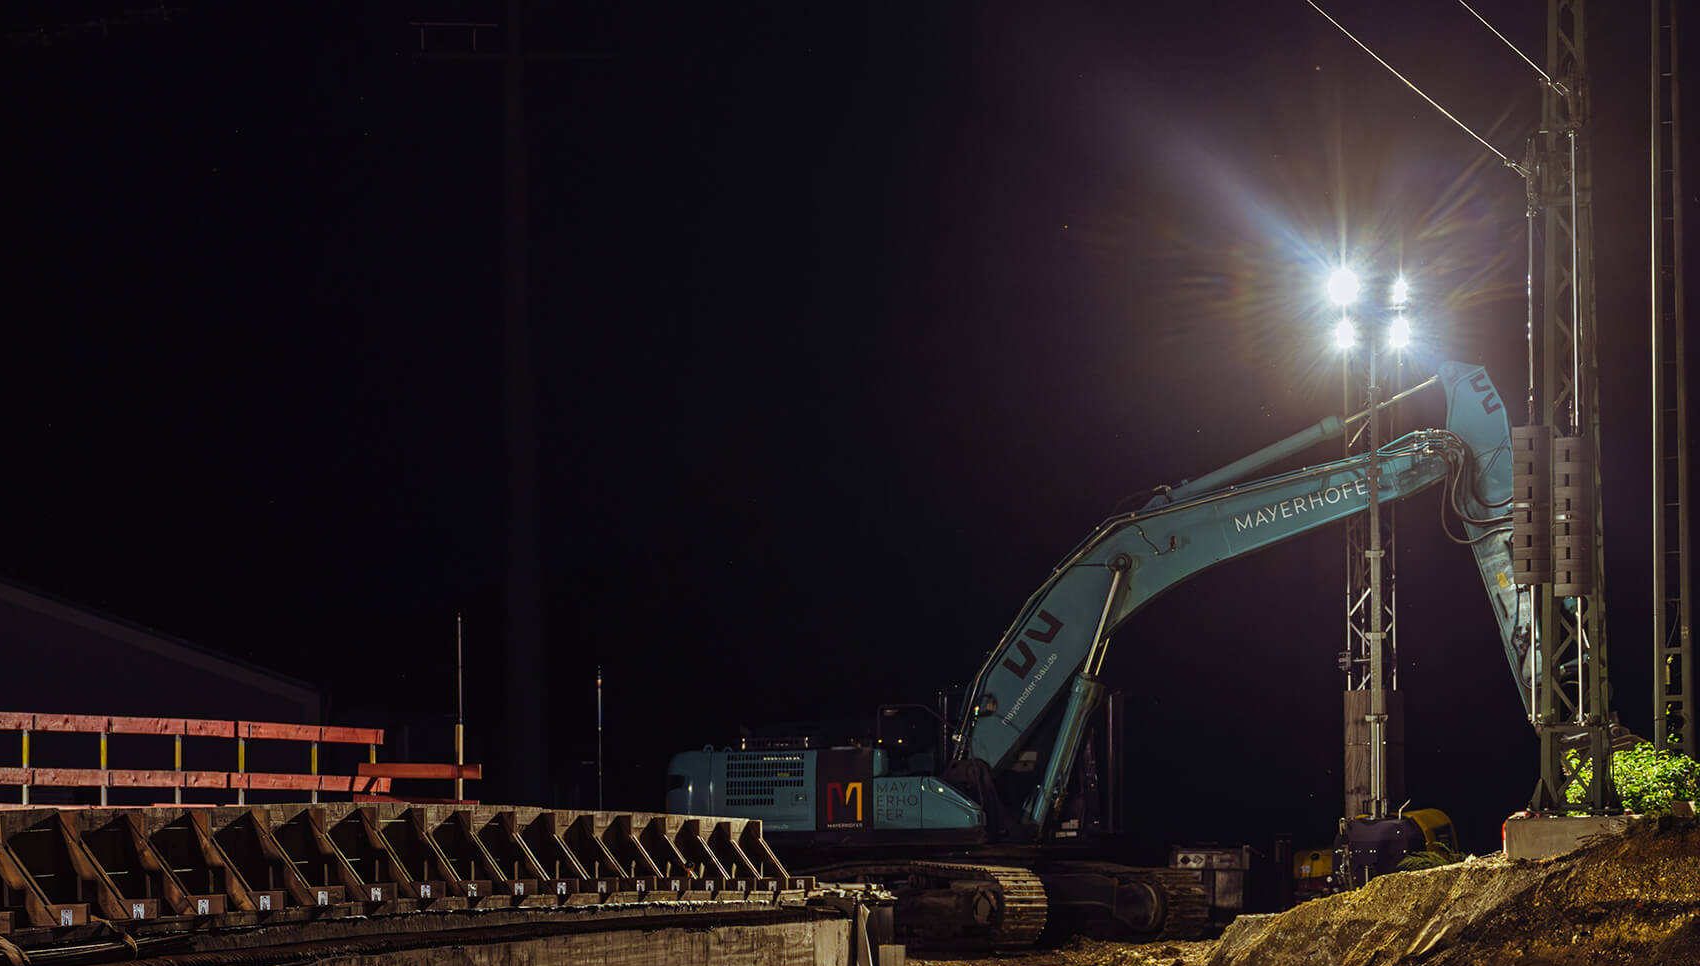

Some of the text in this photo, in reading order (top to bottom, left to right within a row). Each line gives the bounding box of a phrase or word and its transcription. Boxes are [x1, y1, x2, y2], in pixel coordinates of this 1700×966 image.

[1234, 478, 1379, 532] MAYERHOFE
[1002, 653, 1058, 725] mayerhofer-bau.de
[876, 782, 908, 793] MAY
[876, 795, 918, 807] ERHO
